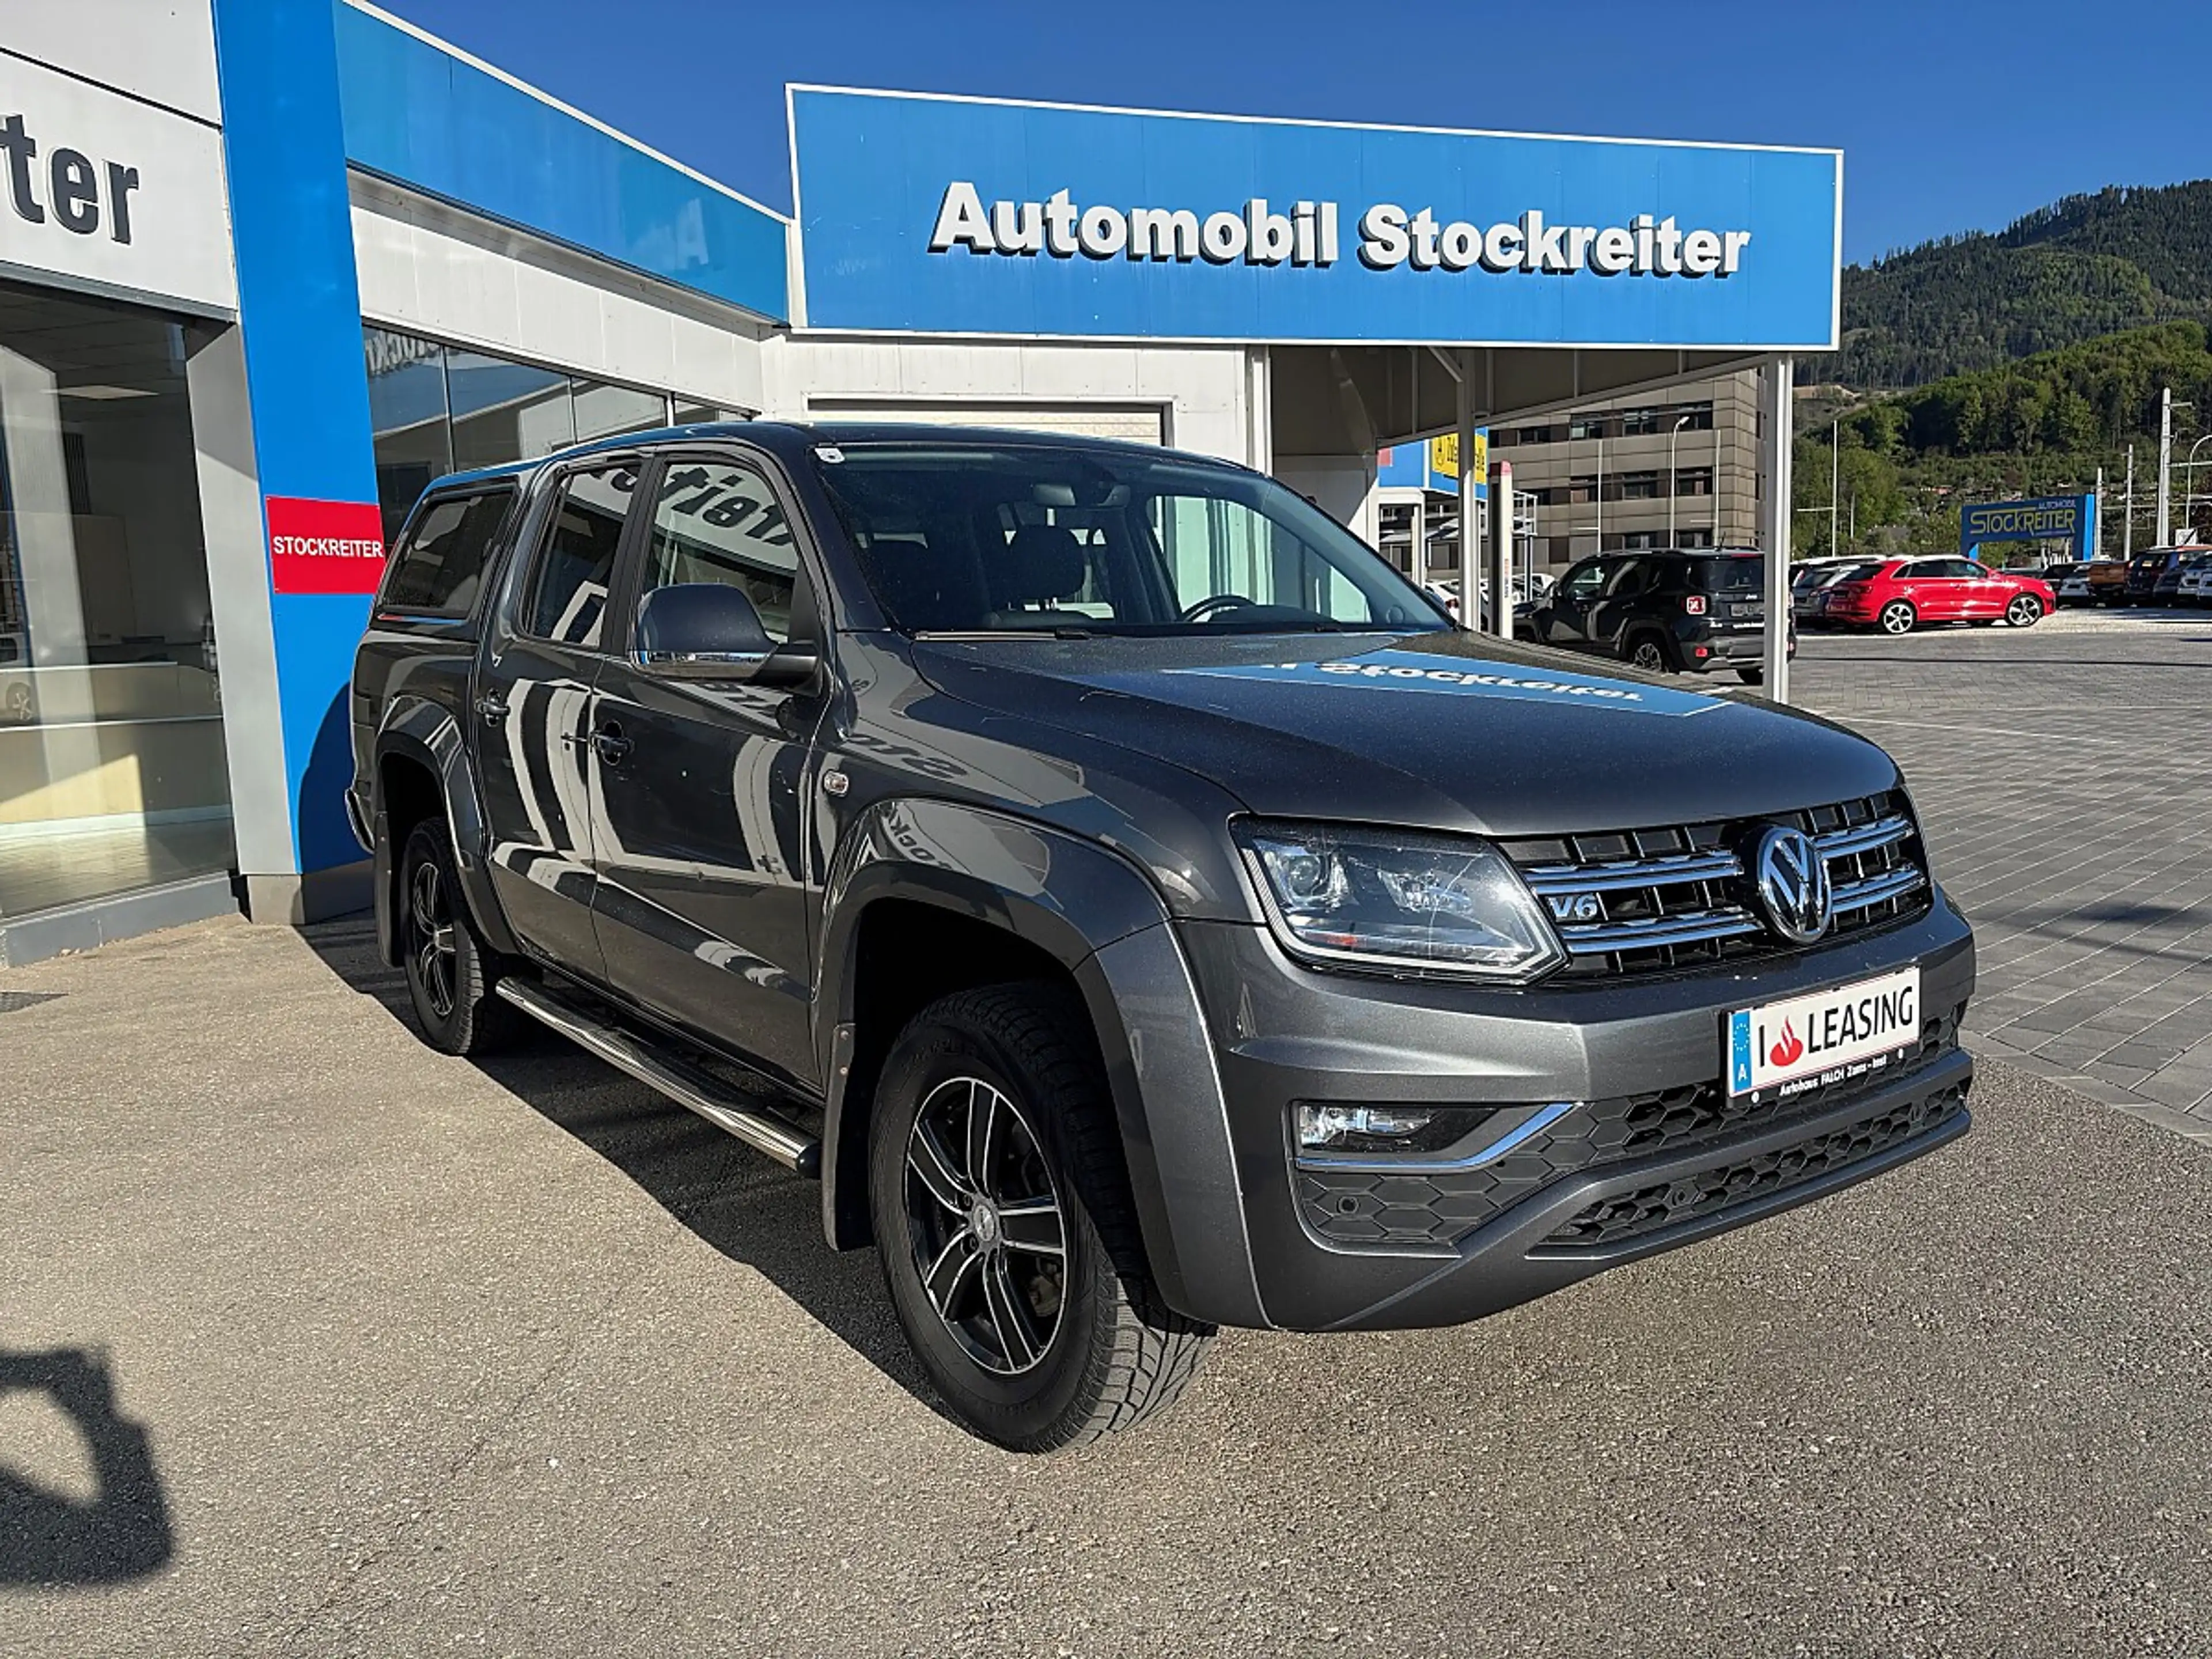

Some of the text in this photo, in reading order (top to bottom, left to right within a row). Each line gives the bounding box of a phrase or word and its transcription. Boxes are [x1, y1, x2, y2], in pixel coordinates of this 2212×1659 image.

[930, 180, 1751, 278] Automobil Stockreiter
[273, 536, 384, 558] STOCKREITER
[1545, 893, 1597, 921] V6
[1758, 986, 1913, 1067] I LEASING
[1737, 1063, 1748, 1082] A
[1779, 1078, 1819, 1096] Autohaus
[1821, 1069, 1844, 1086] FALCH
